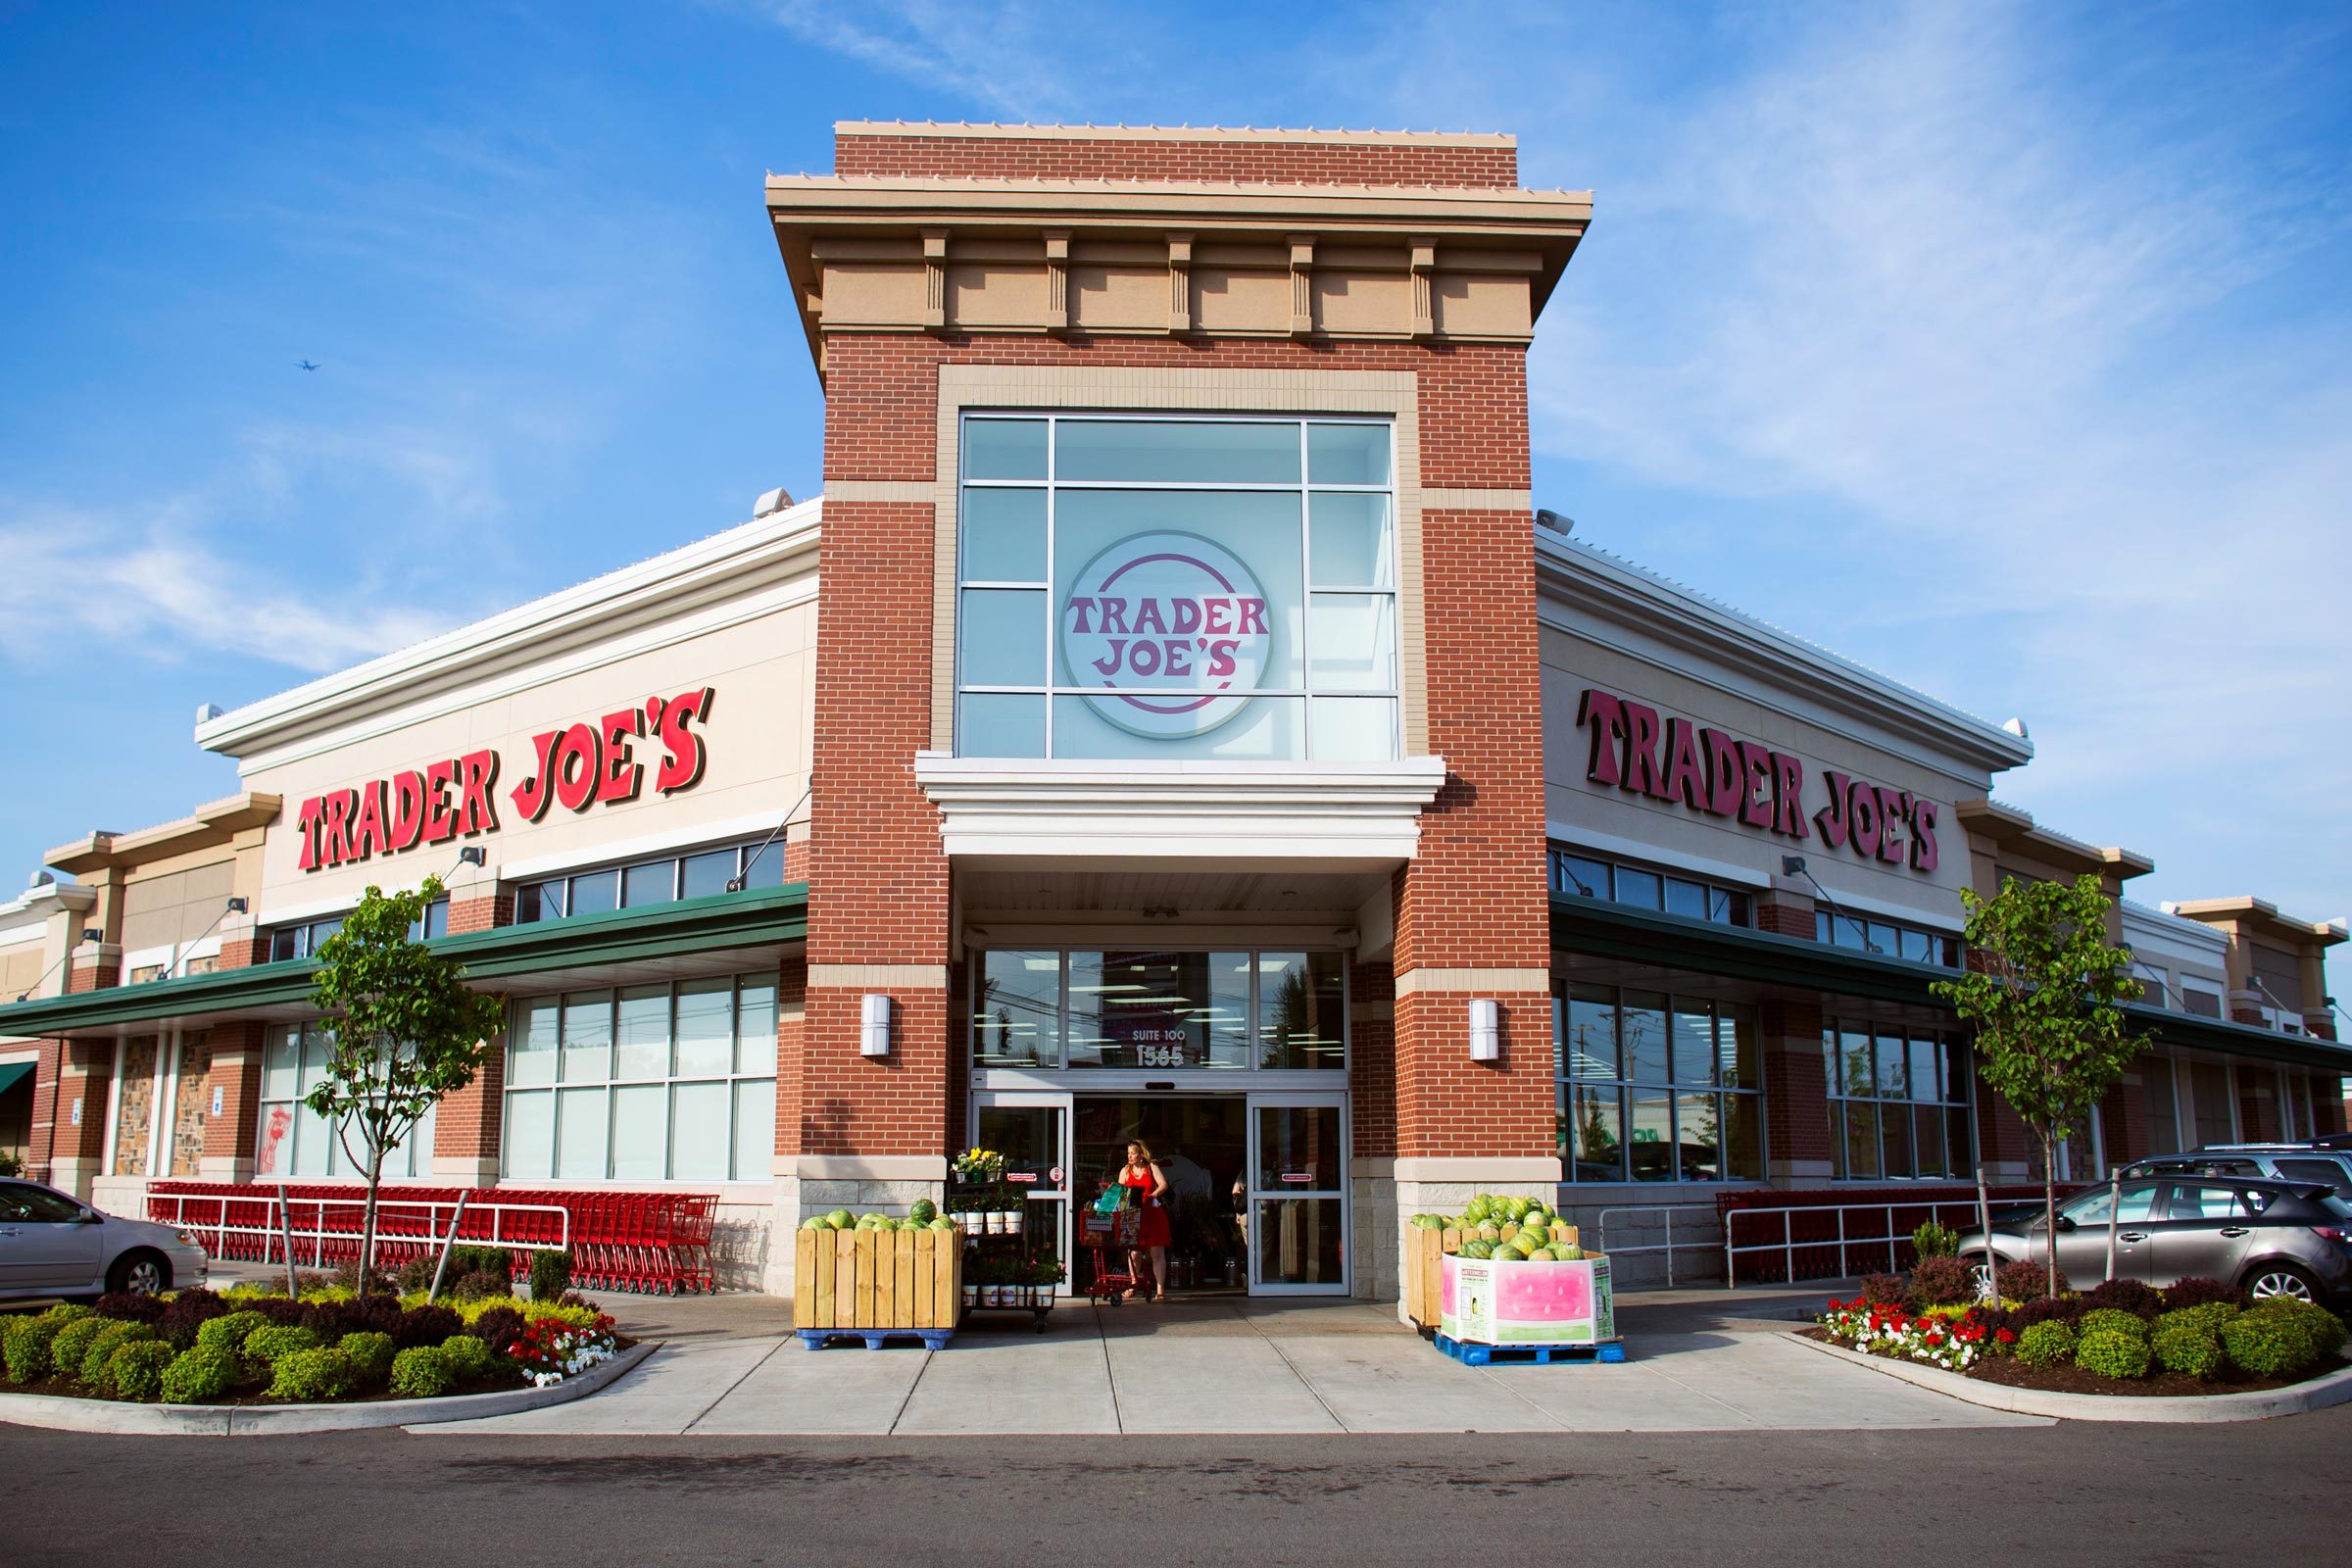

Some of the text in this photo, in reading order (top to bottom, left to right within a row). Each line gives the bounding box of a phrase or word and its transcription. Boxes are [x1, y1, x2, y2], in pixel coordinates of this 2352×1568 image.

[1066, 597, 1270, 635] TRADER
[1091, 637, 1242, 677] JOE'S
[297, 686, 715, 872] TRADER JOE'S
[1576, 688, 1939, 871] TRADER JOE'S
[1132, 1030, 1186, 1041] SUITE 100
[1136, 1045, 1185, 1067] 1565
